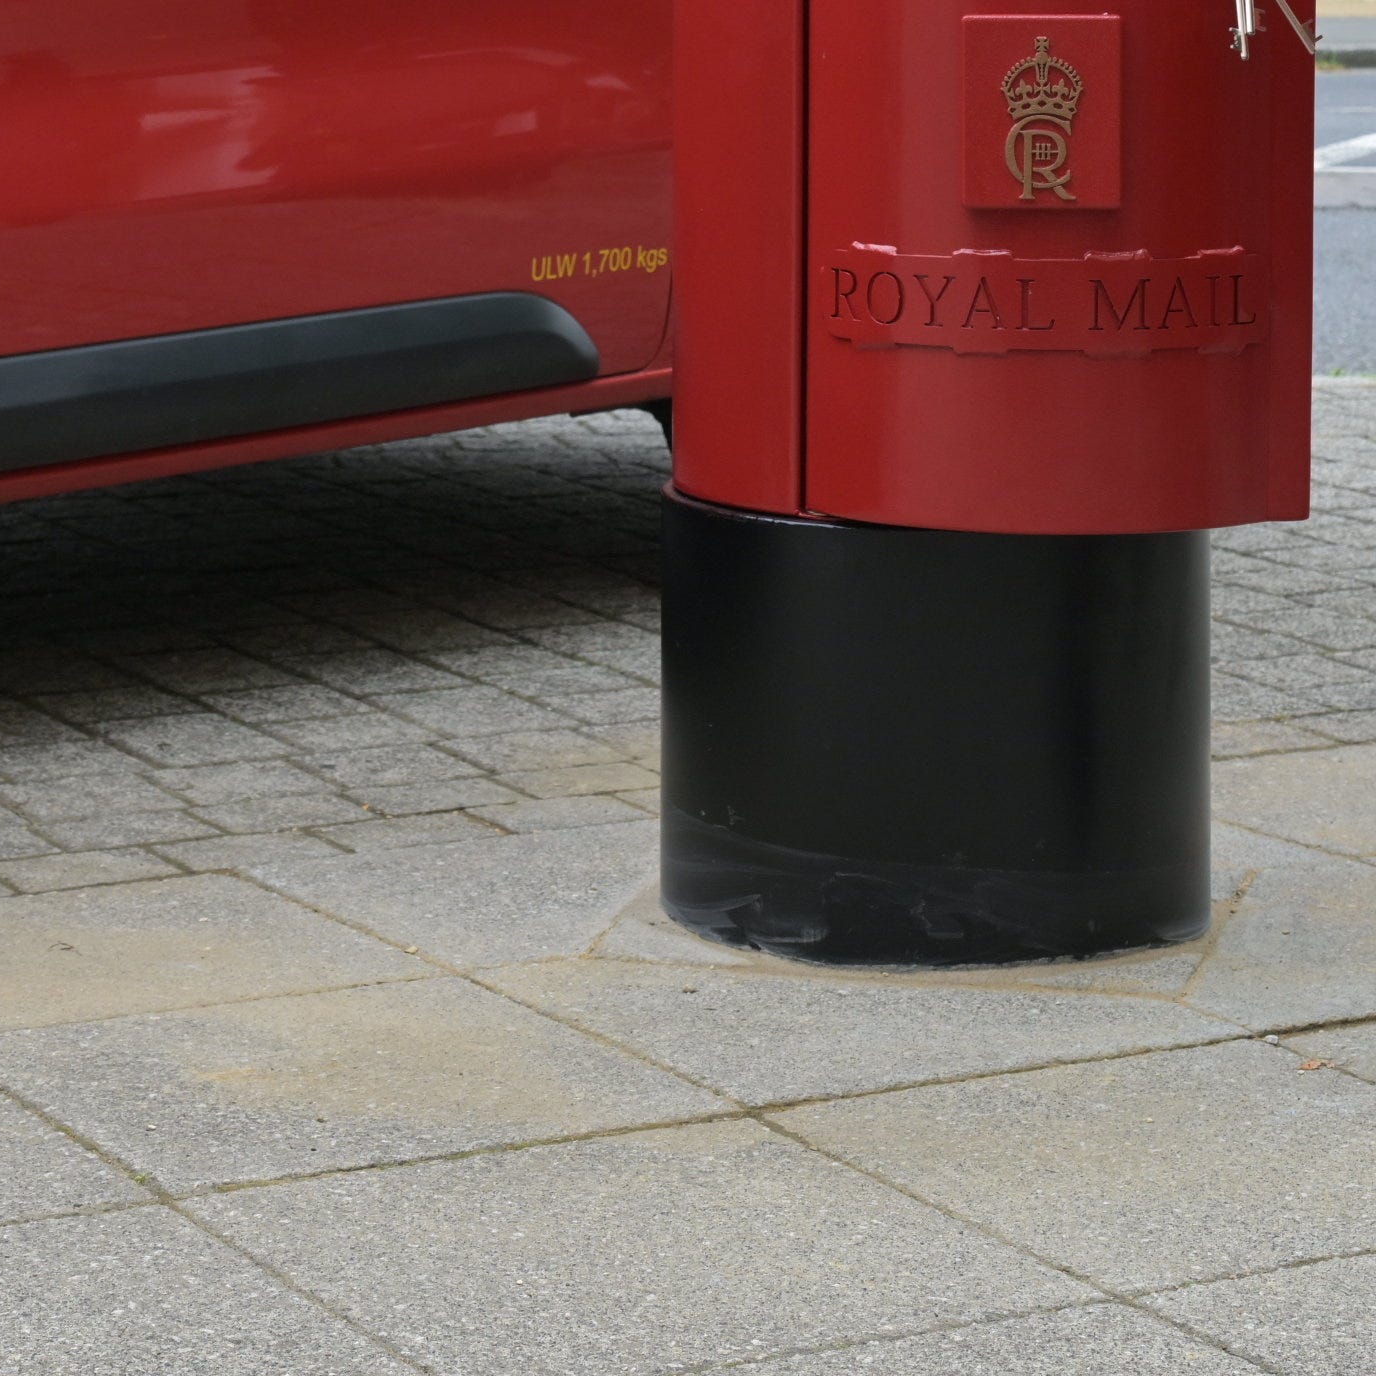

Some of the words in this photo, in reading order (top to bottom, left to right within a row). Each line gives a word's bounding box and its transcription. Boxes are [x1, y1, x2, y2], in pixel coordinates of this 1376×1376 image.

[531, 252, 577, 281] ULW
[582, 246, 632, 278] 1,700
[636, 245, 668, 273] kgs
[830, 267, 1056, 331] ROYAL
[1087, 274, 1257, 331] MAIL
